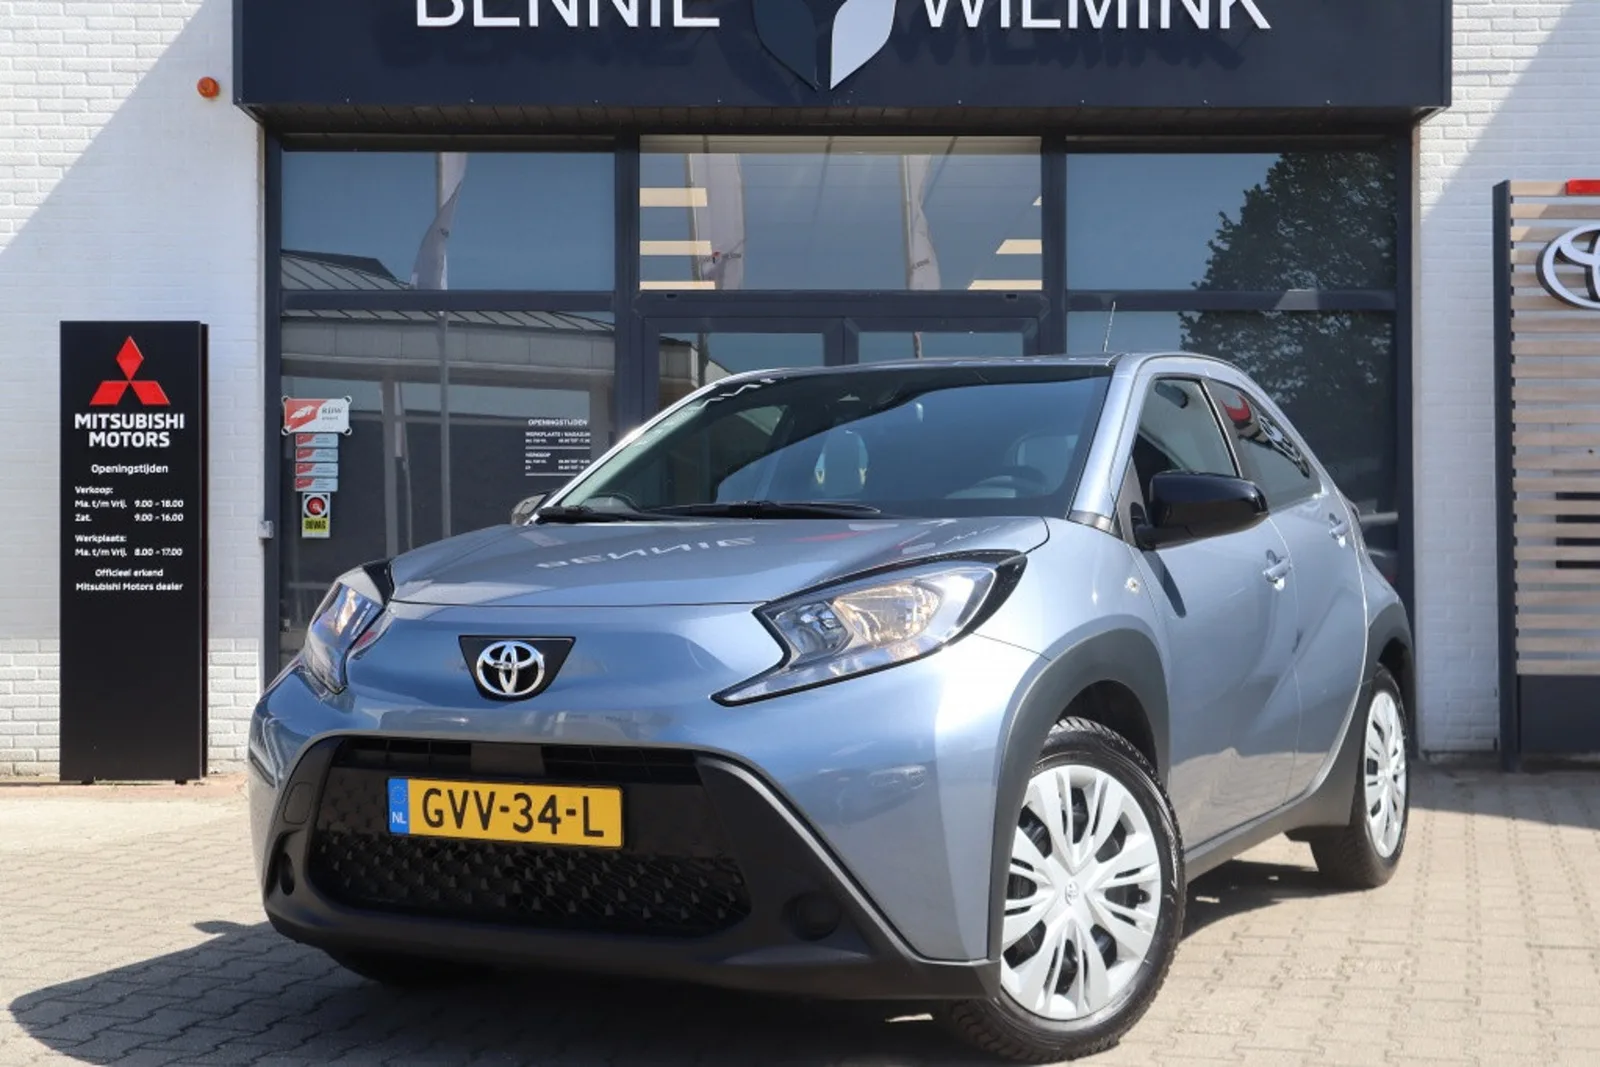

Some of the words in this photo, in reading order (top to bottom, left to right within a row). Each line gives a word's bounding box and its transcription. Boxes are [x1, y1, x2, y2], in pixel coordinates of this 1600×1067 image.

[74, 413, 185, 429] MITSUBISHI
[88, 431, 170, 448] MOTORS
[91, 464, 169, 475] Openingstijden
[74, 486, 114, 495] Verkoop:
[74, 500, 91, 508] Ma.
[92, 500, 110, 509] t/m
[134, 500, 153, 508] 9.00
[161, 500, 184, 508] 18.00
[74, 514, 92, 522] Zat.
[134, 513, 153, 521] 9.00
[161, 513, 184, 521] 16.00
[74, 535, 127, 544] Werkplaats:
[74, 548, 91, 556] Ma.
[92, 548, 110, 557] t/m
[134, 548, 153, 556] 8.00
[161, 548, 183, 556] 17.00
[95, 568, 132, 577] Officieel
[133, 568, 164, 577] erkend
[75, 582, 121, 591] Mitsubishi
[123, 582, 154, 591] Motors
[155, 582, 184, 591] dealer
[422, 787, 605, 838] GVV-34-L
[391, 811, 407, 825] NL
